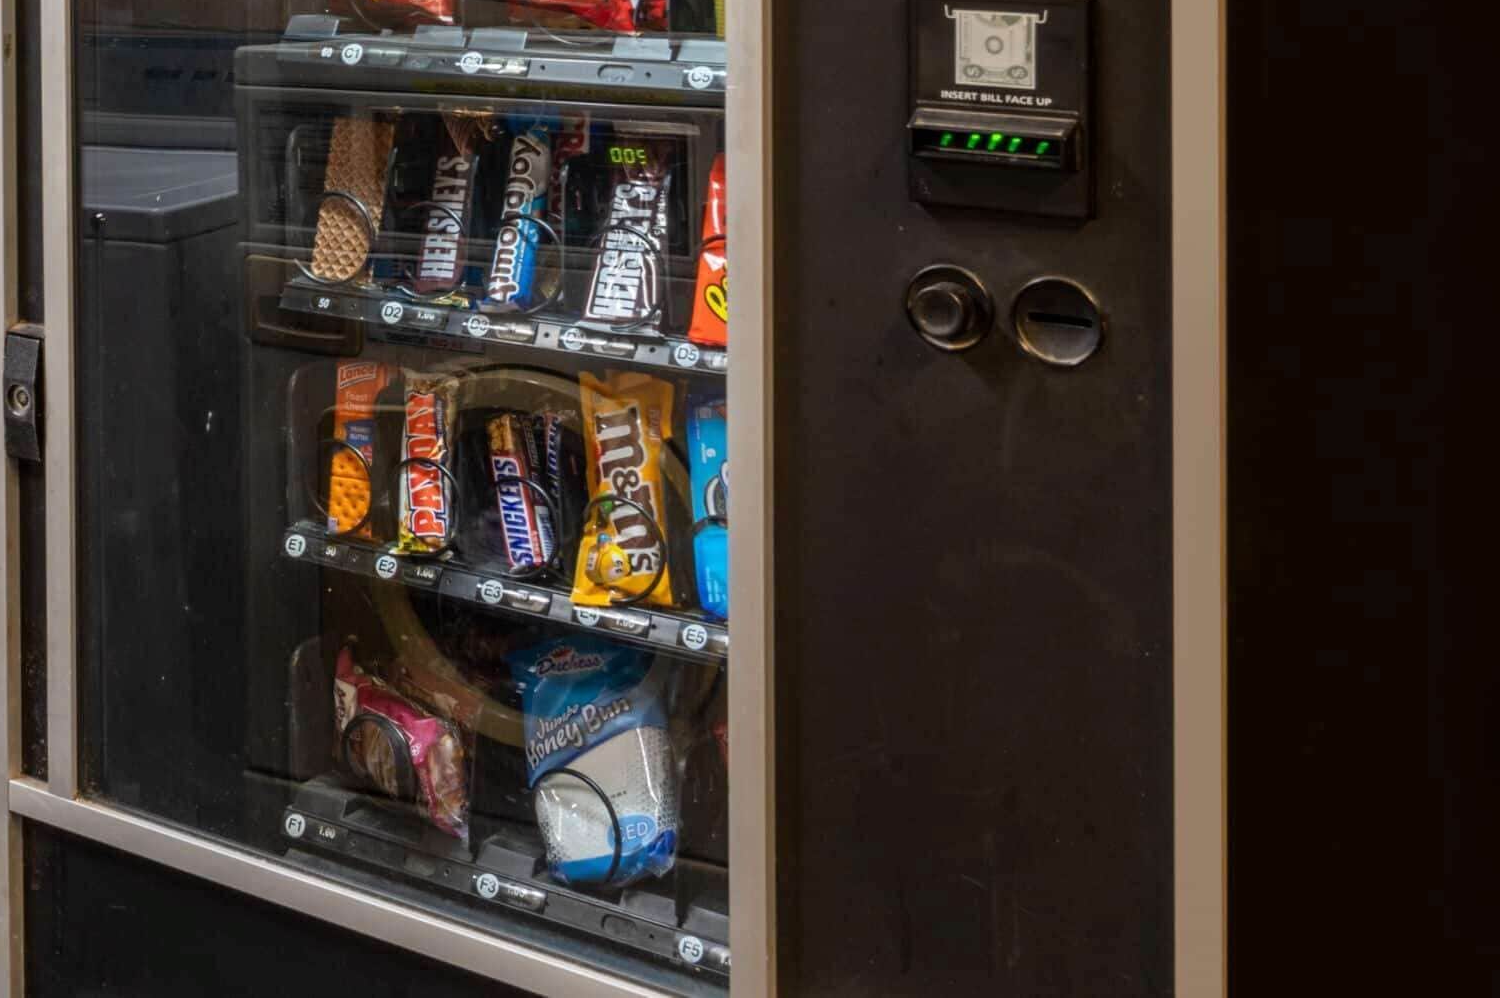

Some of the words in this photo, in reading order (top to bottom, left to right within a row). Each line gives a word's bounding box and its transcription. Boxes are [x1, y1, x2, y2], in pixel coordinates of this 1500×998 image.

[344, 46, 360, 60] C1
[941, 90, 978, 102] INSERT
[980, 92, 1002, 104] BILL
[1005, 94, 1034, 106] FACE
[1036, 95, 1052, 107] UP
[419, 155, 471, 279] HERSHEY'S
[317, 297, 330, 309] 50
[384, 305, 402, 319] D2
[676, 347, 697, 362] D5
[340, 364, 377, 385] Lance
[406, 392, 446, 537] PAYDAY
[493, 457, 534, 569] SNICKERS
[288, 538, 303, 553] E1
[379, 560, 396, 574] E2
[414, 567, 435, 579] 1.00
[484, 584, 501, 597] E3
[685, 628, 705, 644] E5
[536, 655, 602, 677] Duchess
[536, 704, 580, 740] Jumbo
[525, 721, 585, 771] Honey
[581, 697, 632, 734] Bun
[288, 819, 302, 833] F1
[318, 825, 336, 839] 1.00
[614, 821, 649, 844] CED
[480, 877, 497, 894] F3
[681, 941, 701, 957] F5
